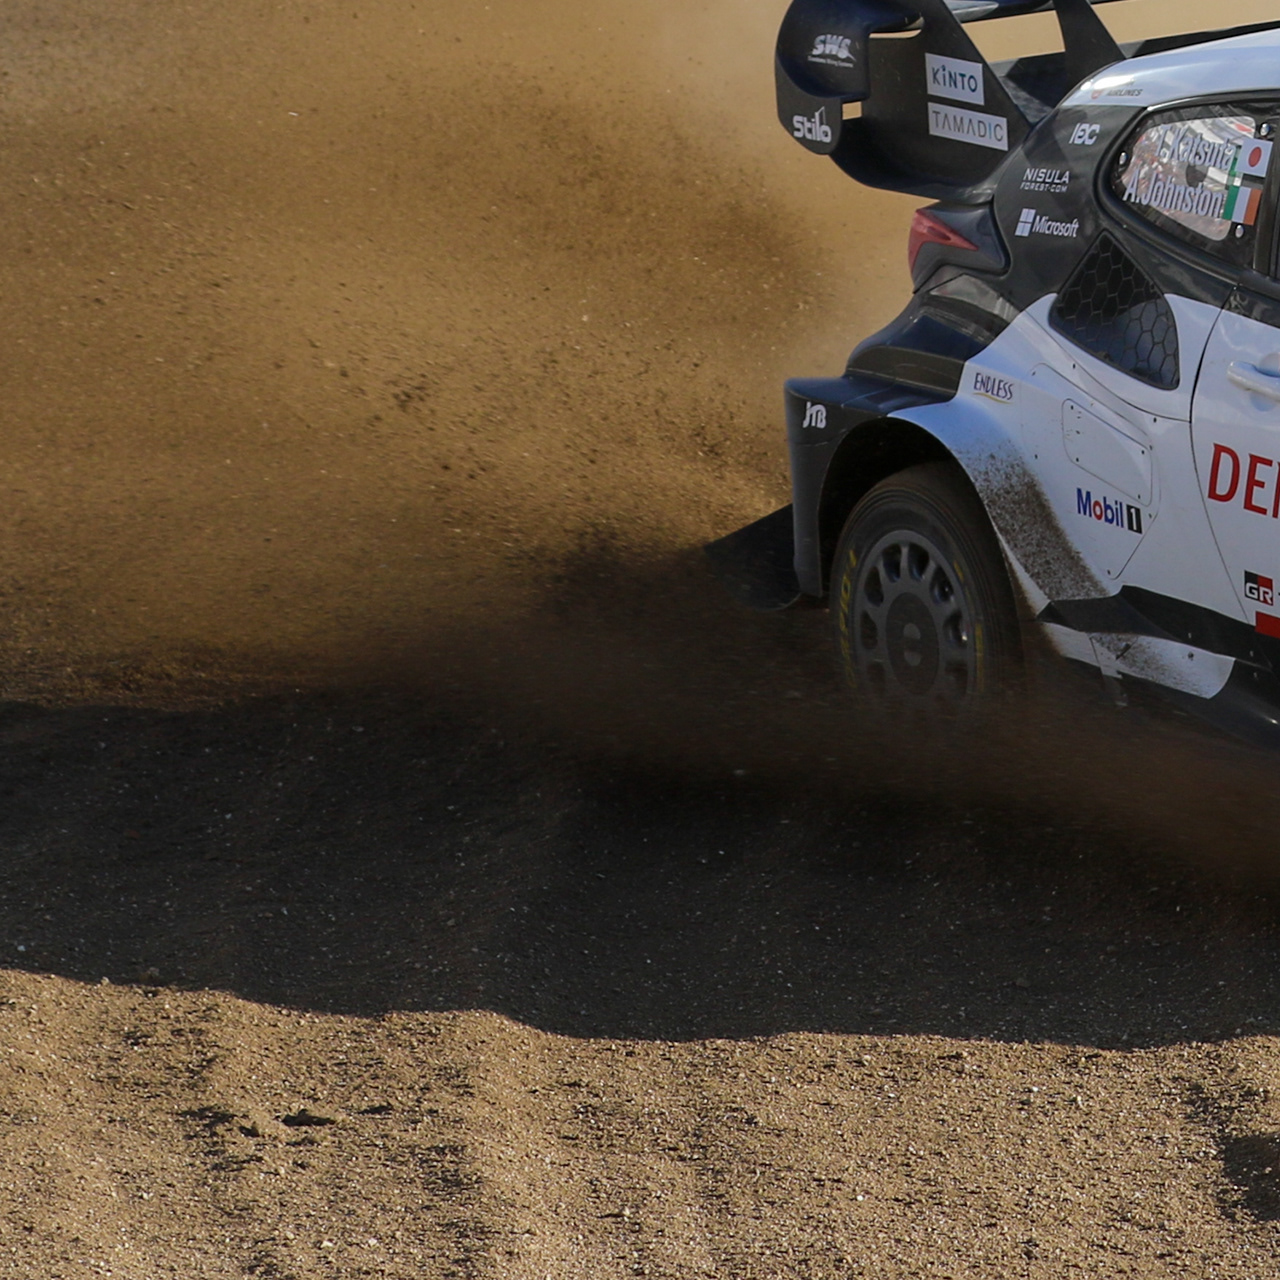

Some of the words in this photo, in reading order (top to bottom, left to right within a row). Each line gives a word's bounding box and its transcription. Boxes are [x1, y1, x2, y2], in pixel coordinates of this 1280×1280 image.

[793, 106, 832, 143] Stilo
[932, 110, 1004, 142] TAMADIC
[1023, 168, 1070, 184] NISULA
[1032, 214, 1080, 238] Microsoft
[973, 372, 1015, 400] ENDLESS
[1076, 487, 1125, 528] Mobil
[1127, 505, 1142, 534] 1
[1244, 582, 1273, 605] GR
